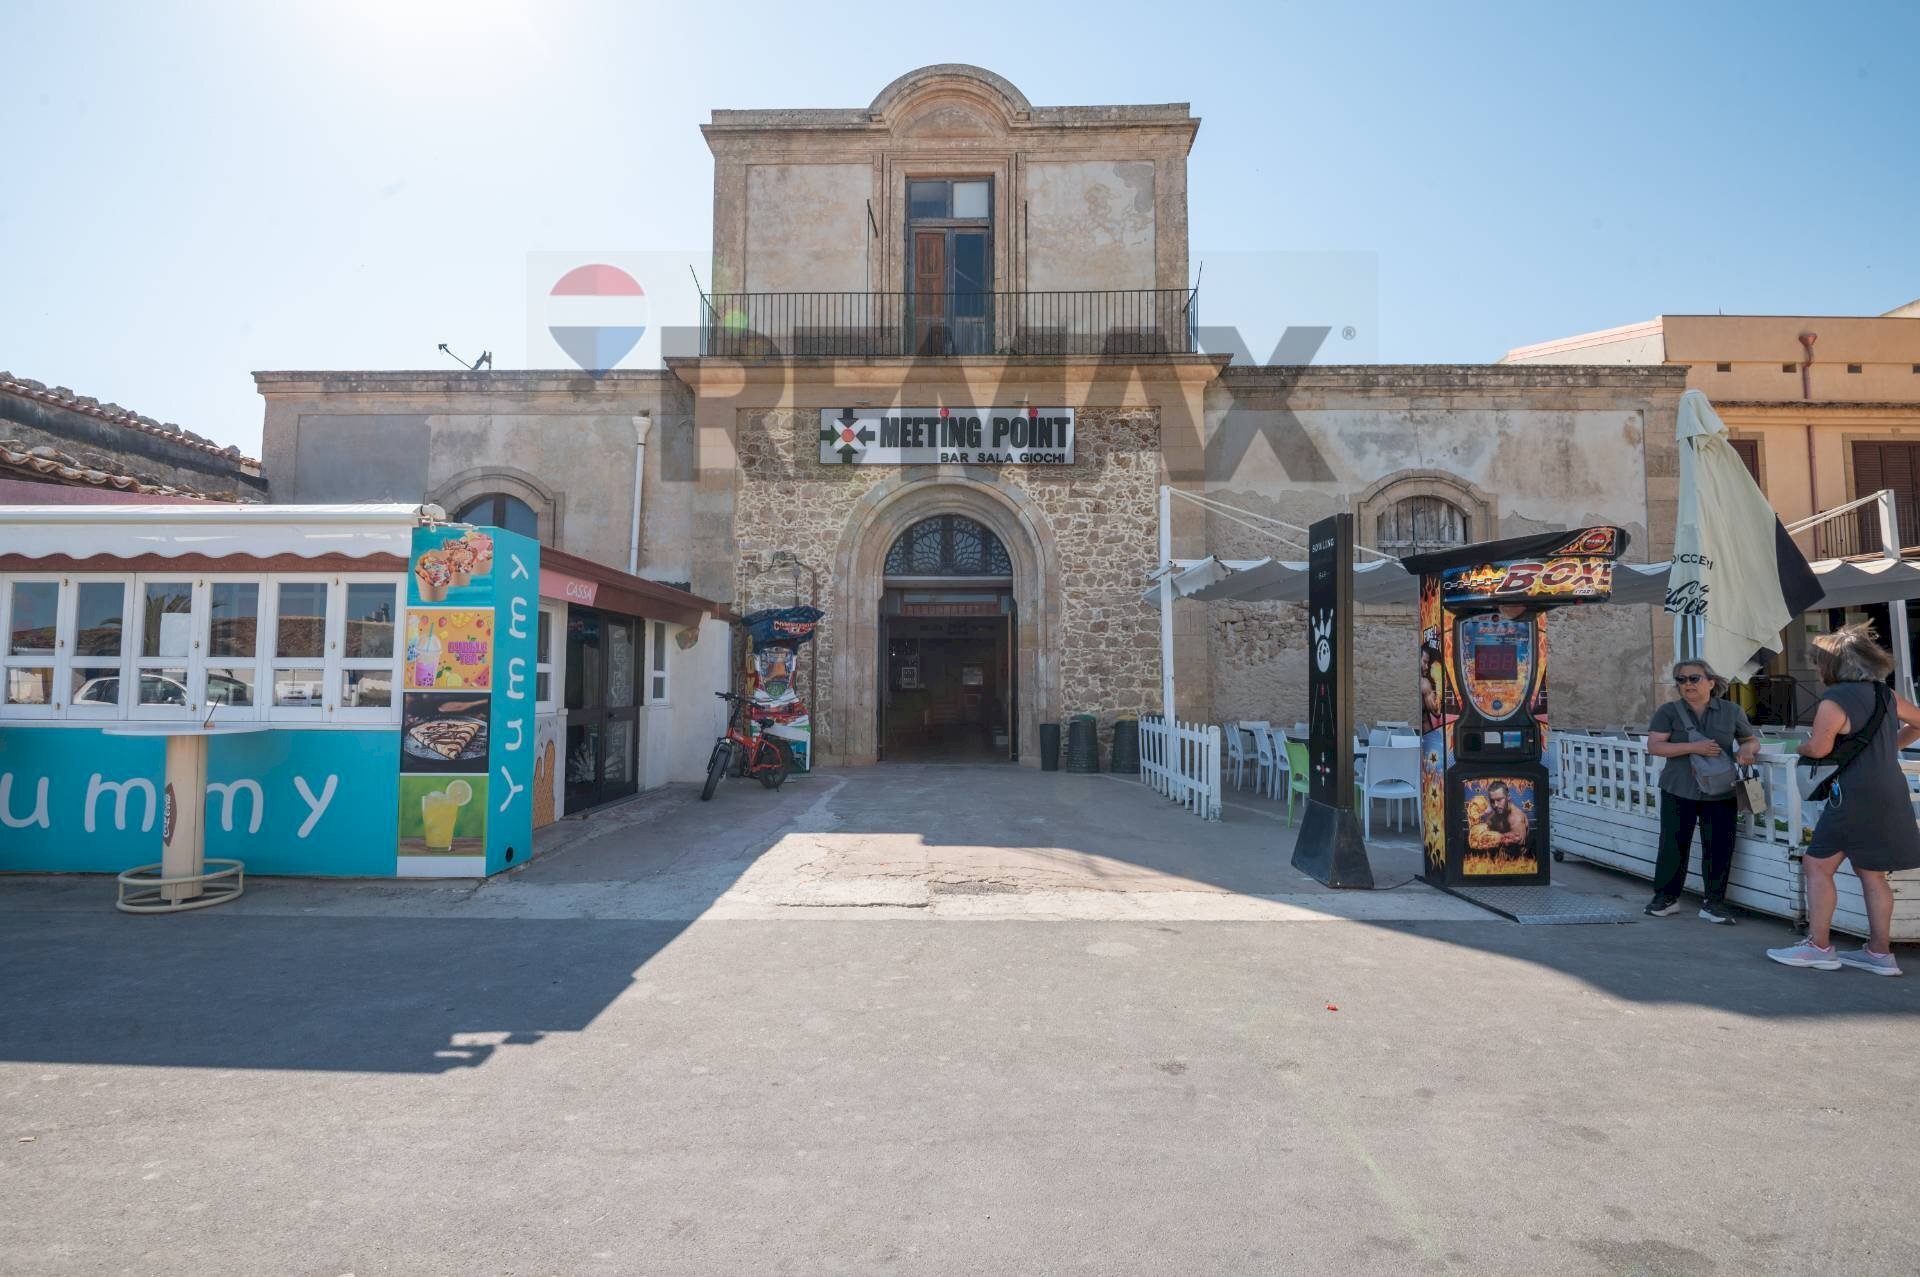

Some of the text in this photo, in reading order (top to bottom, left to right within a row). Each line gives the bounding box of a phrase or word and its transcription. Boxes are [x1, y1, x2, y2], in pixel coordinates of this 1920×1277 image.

[880, 408, 1071, 448] MEETING POINT
[940, 452, 1066, 463] BAR SALA GIOCHI
[567, 582, 592, 601] CASSA
